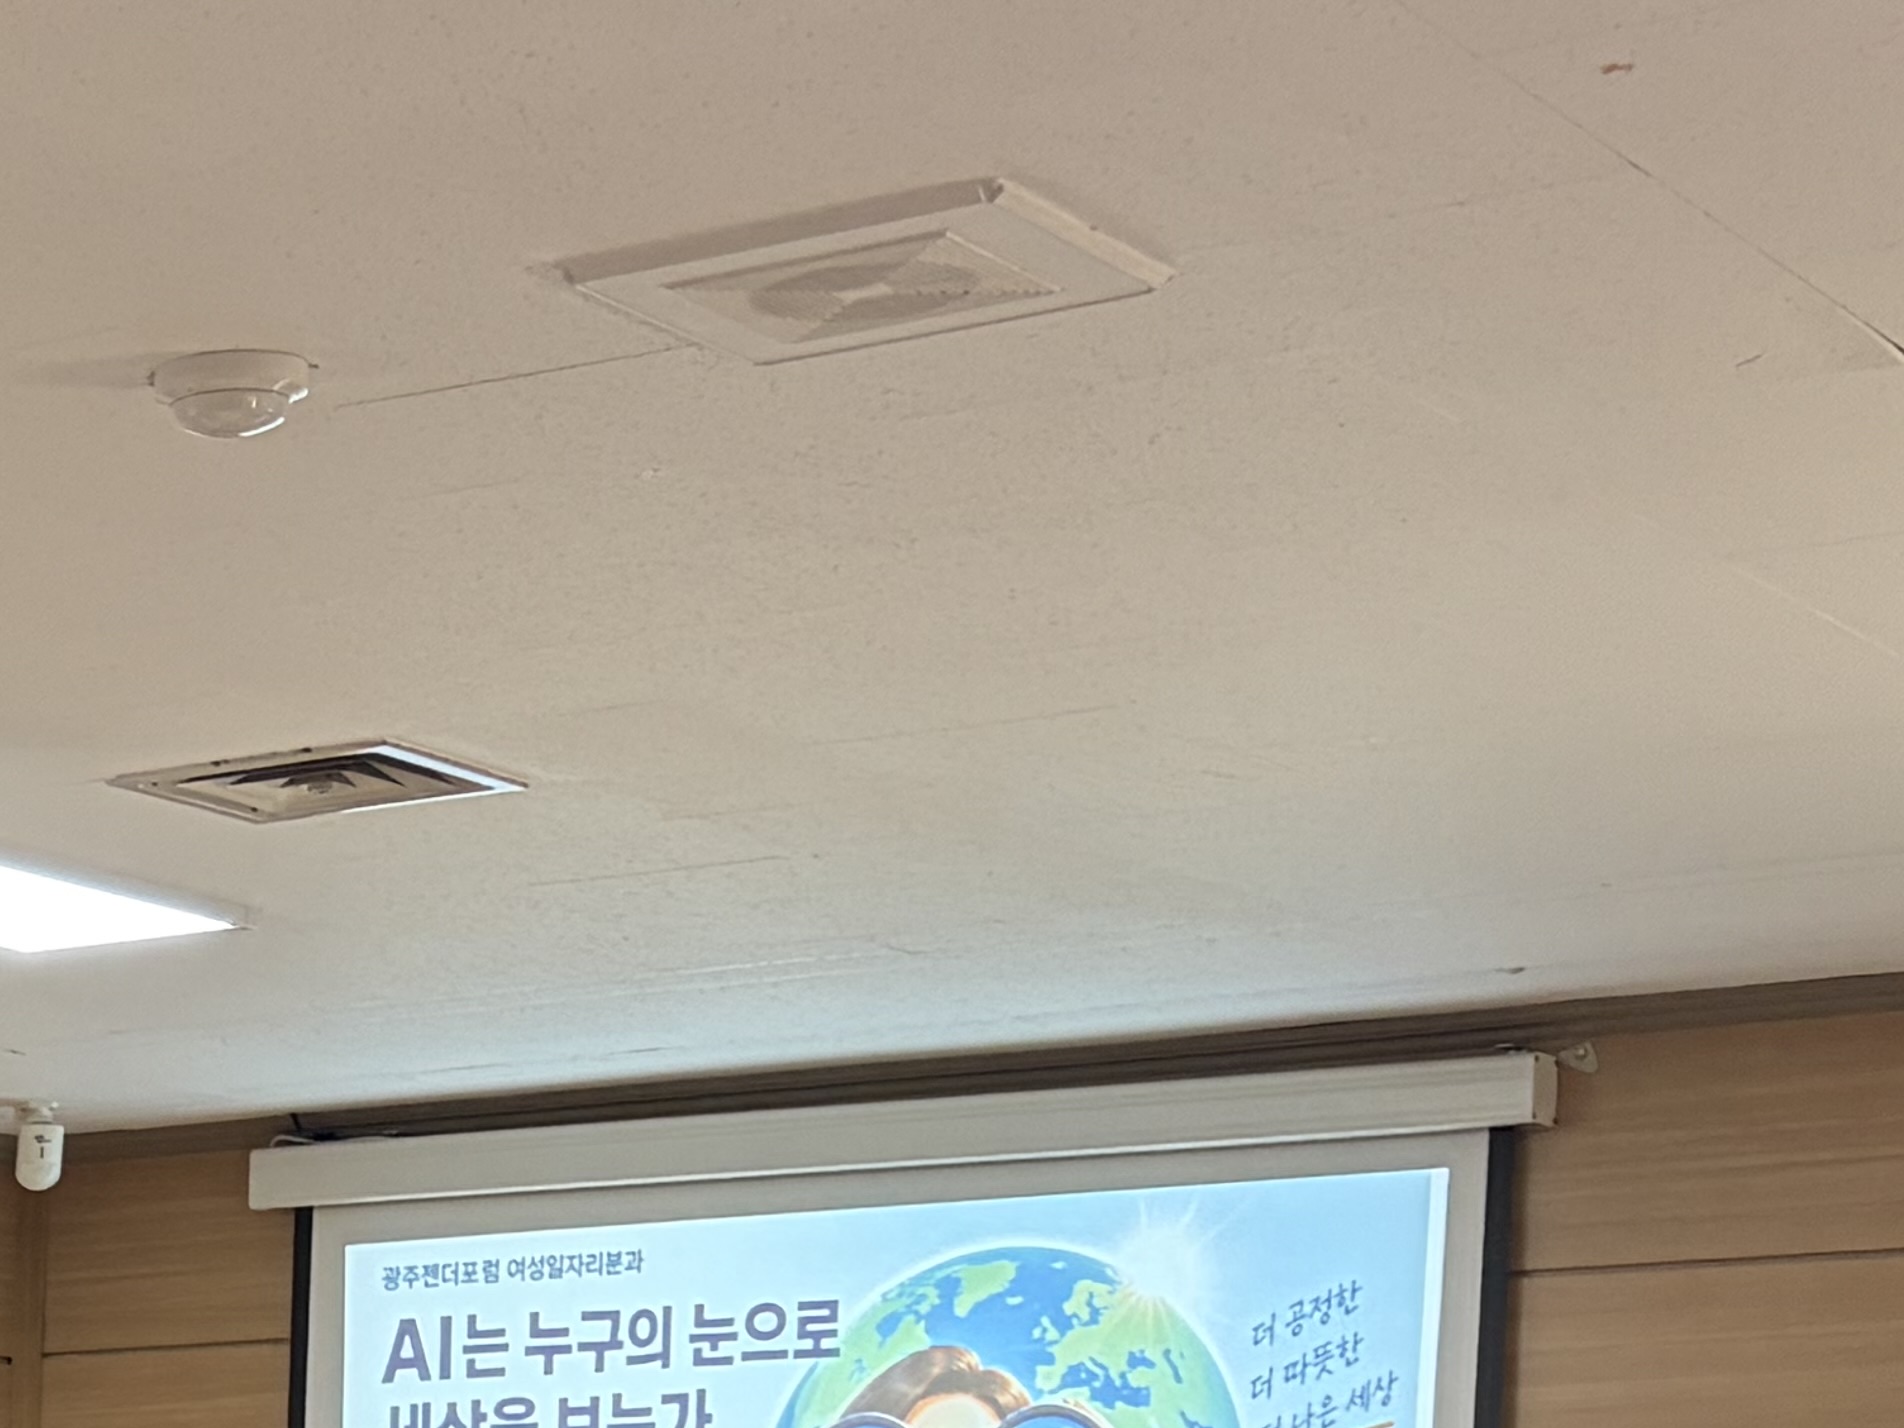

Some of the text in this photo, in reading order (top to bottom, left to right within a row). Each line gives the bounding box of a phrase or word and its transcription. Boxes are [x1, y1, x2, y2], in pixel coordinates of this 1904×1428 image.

[382, 1249, 644, 1292] 광주젠더포럼 여성일자리분과
[381, 1299, 841, 1384] AI는 누구의 눈으로
[1252, 1280, 1364, 1346] 더 공정한
[1250, 1333, 1365, 1401] 더 따뜻한
[1344, 1370, 1401, 1415] 세상
